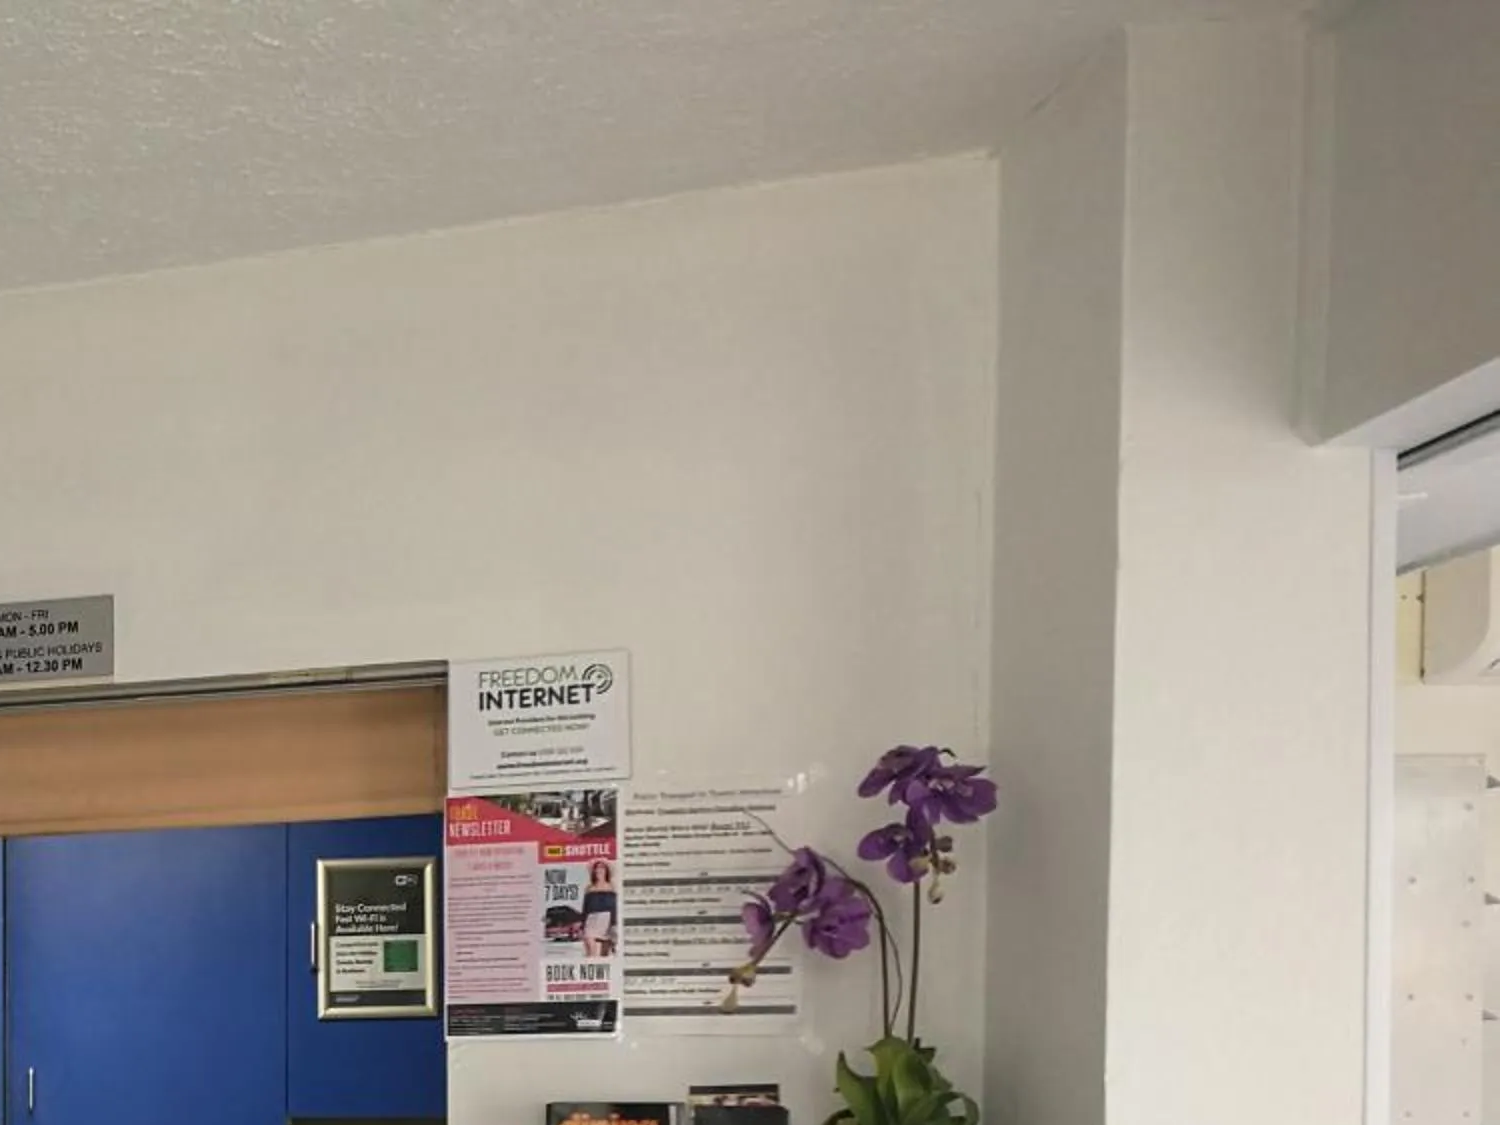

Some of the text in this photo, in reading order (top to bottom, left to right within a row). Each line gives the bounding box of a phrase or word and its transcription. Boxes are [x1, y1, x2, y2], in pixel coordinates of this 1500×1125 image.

[31, 609, 49, 621] FRI
[29, 623, 55, 637] 5.00
[58, 620, 79, 634] PM
[5, 645, 45, 659] PUBLIC
[48, 642, 103, 657] HOLIDAYS
[26, 660, 58, 674] 12.30
[62, 657, 83, 672] PM
[479, 665, 578, 688] FREEDOM
[479, 683, 595, 712] INTERNET
[449, 819, 511, 837] NEWSLETTER
[565, 843, 611, 857] SHUTTLE
[545, 869, 567, 884] NOW
[335, 902, 407, 914] Stay Connected
[546, 964, 575, 982] BOOK
